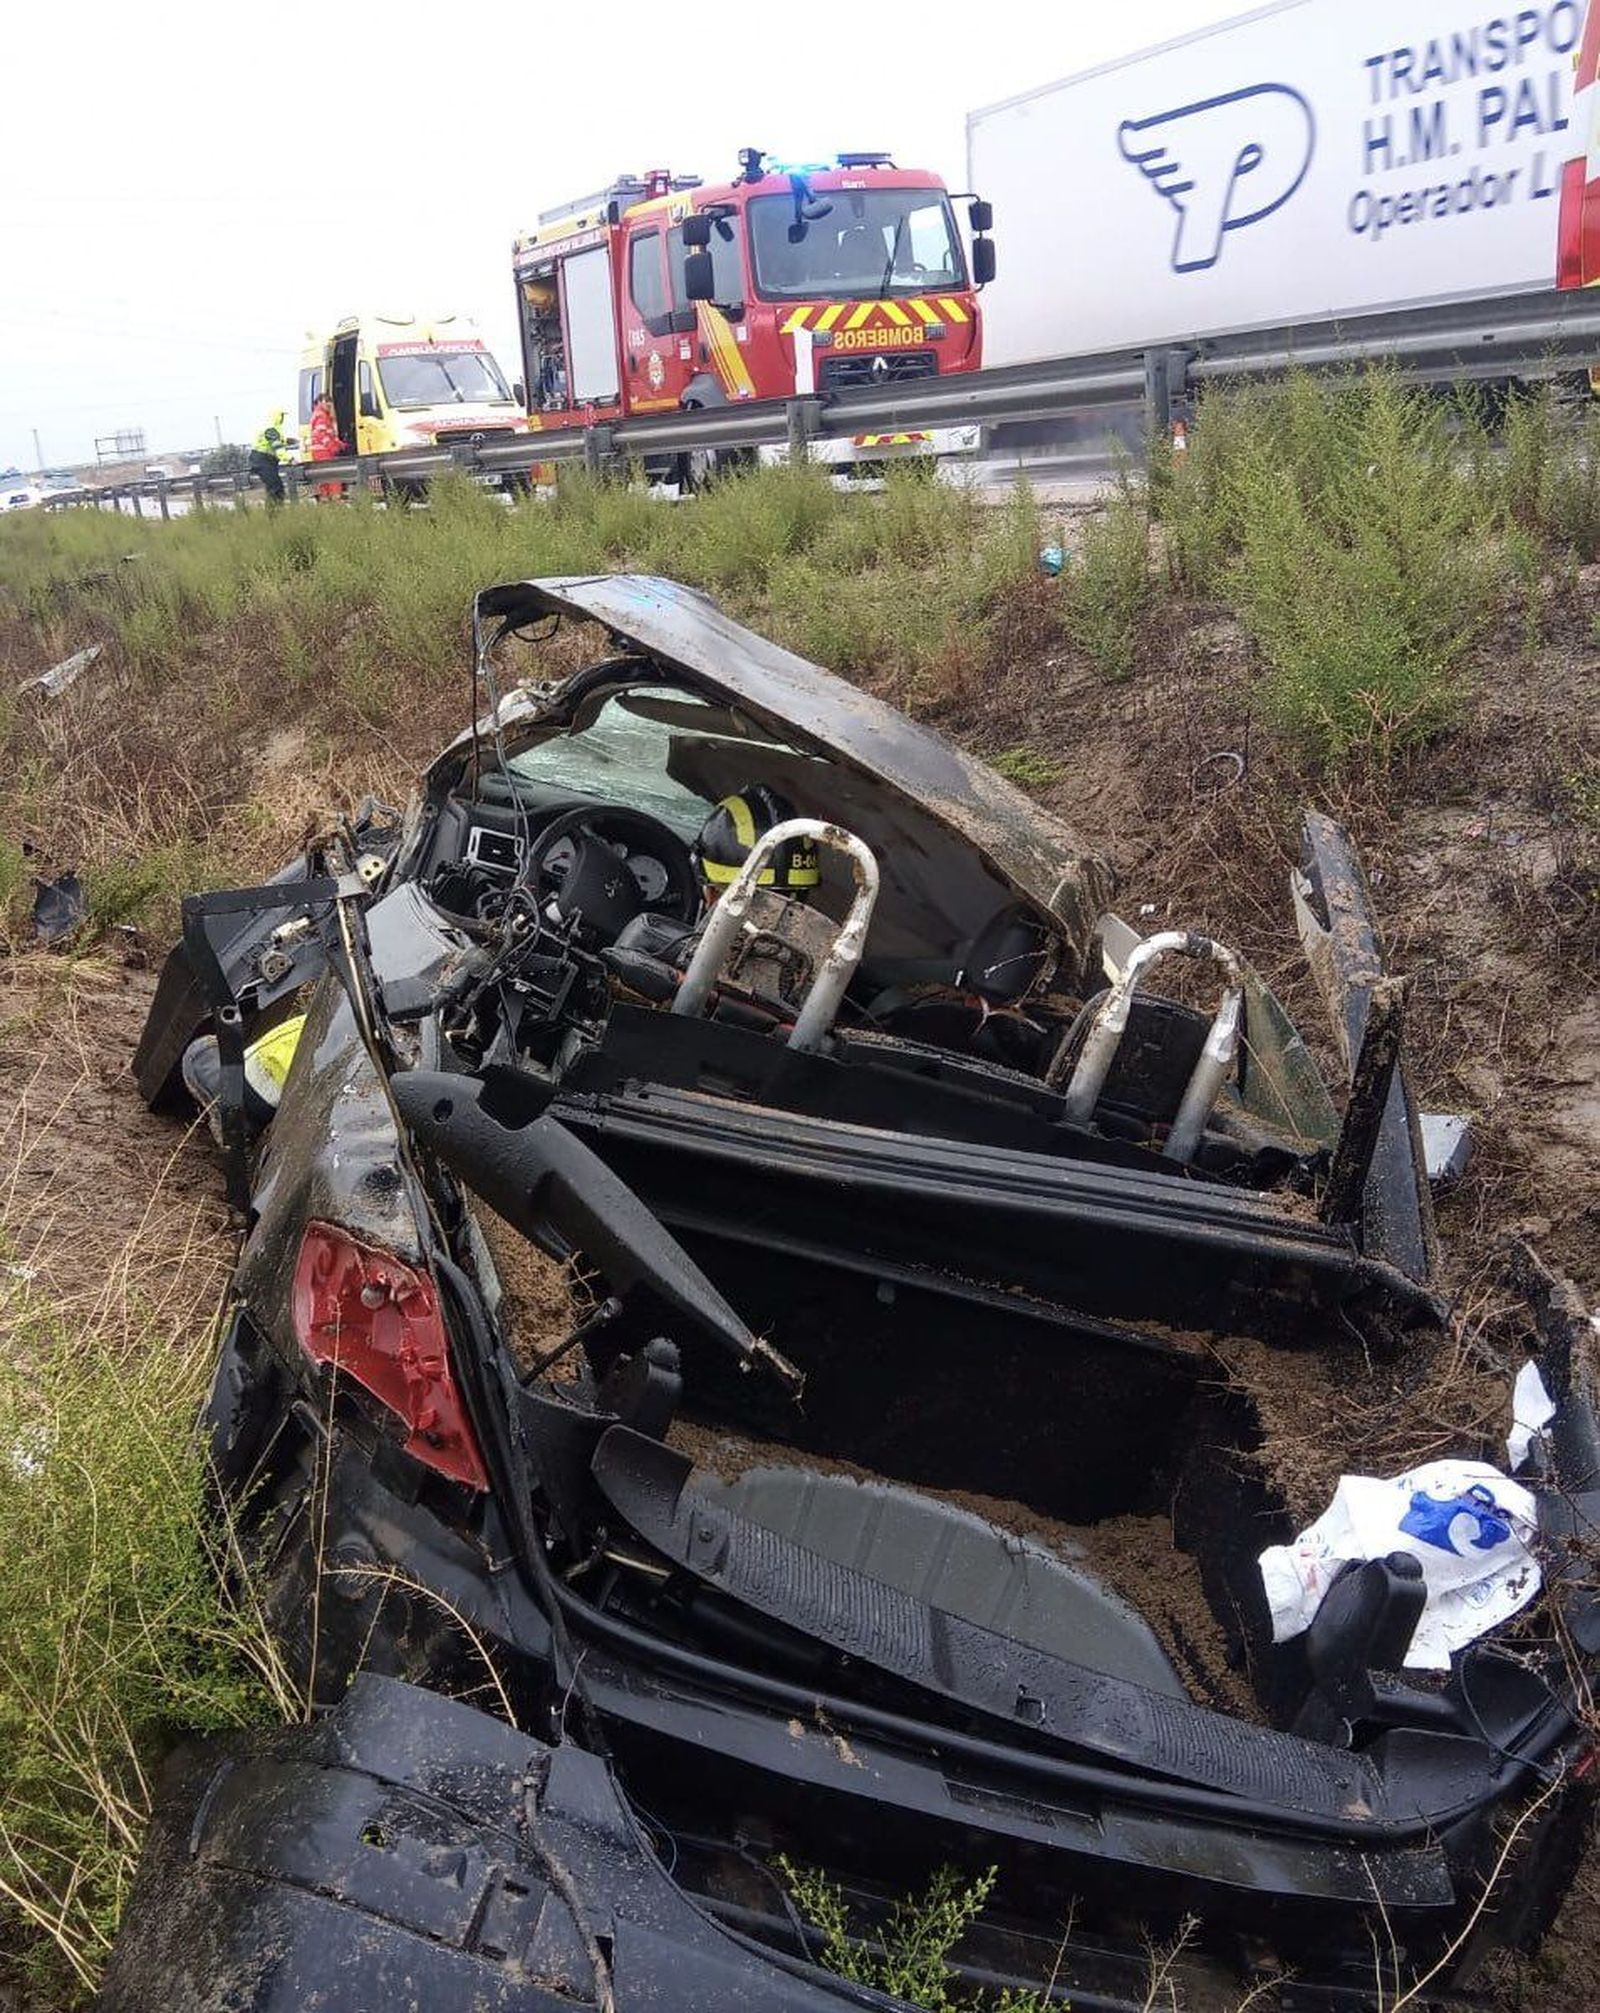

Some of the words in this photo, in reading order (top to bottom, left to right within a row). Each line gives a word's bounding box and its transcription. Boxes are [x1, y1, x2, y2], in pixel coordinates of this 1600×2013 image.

[1364, 0, 1580, 105] TRANSPO
[1363, 100, 1461, 175] H.M.
[1479, 70, 1569, 148] PAL
[1348, 166, 1522, 242] Operador
